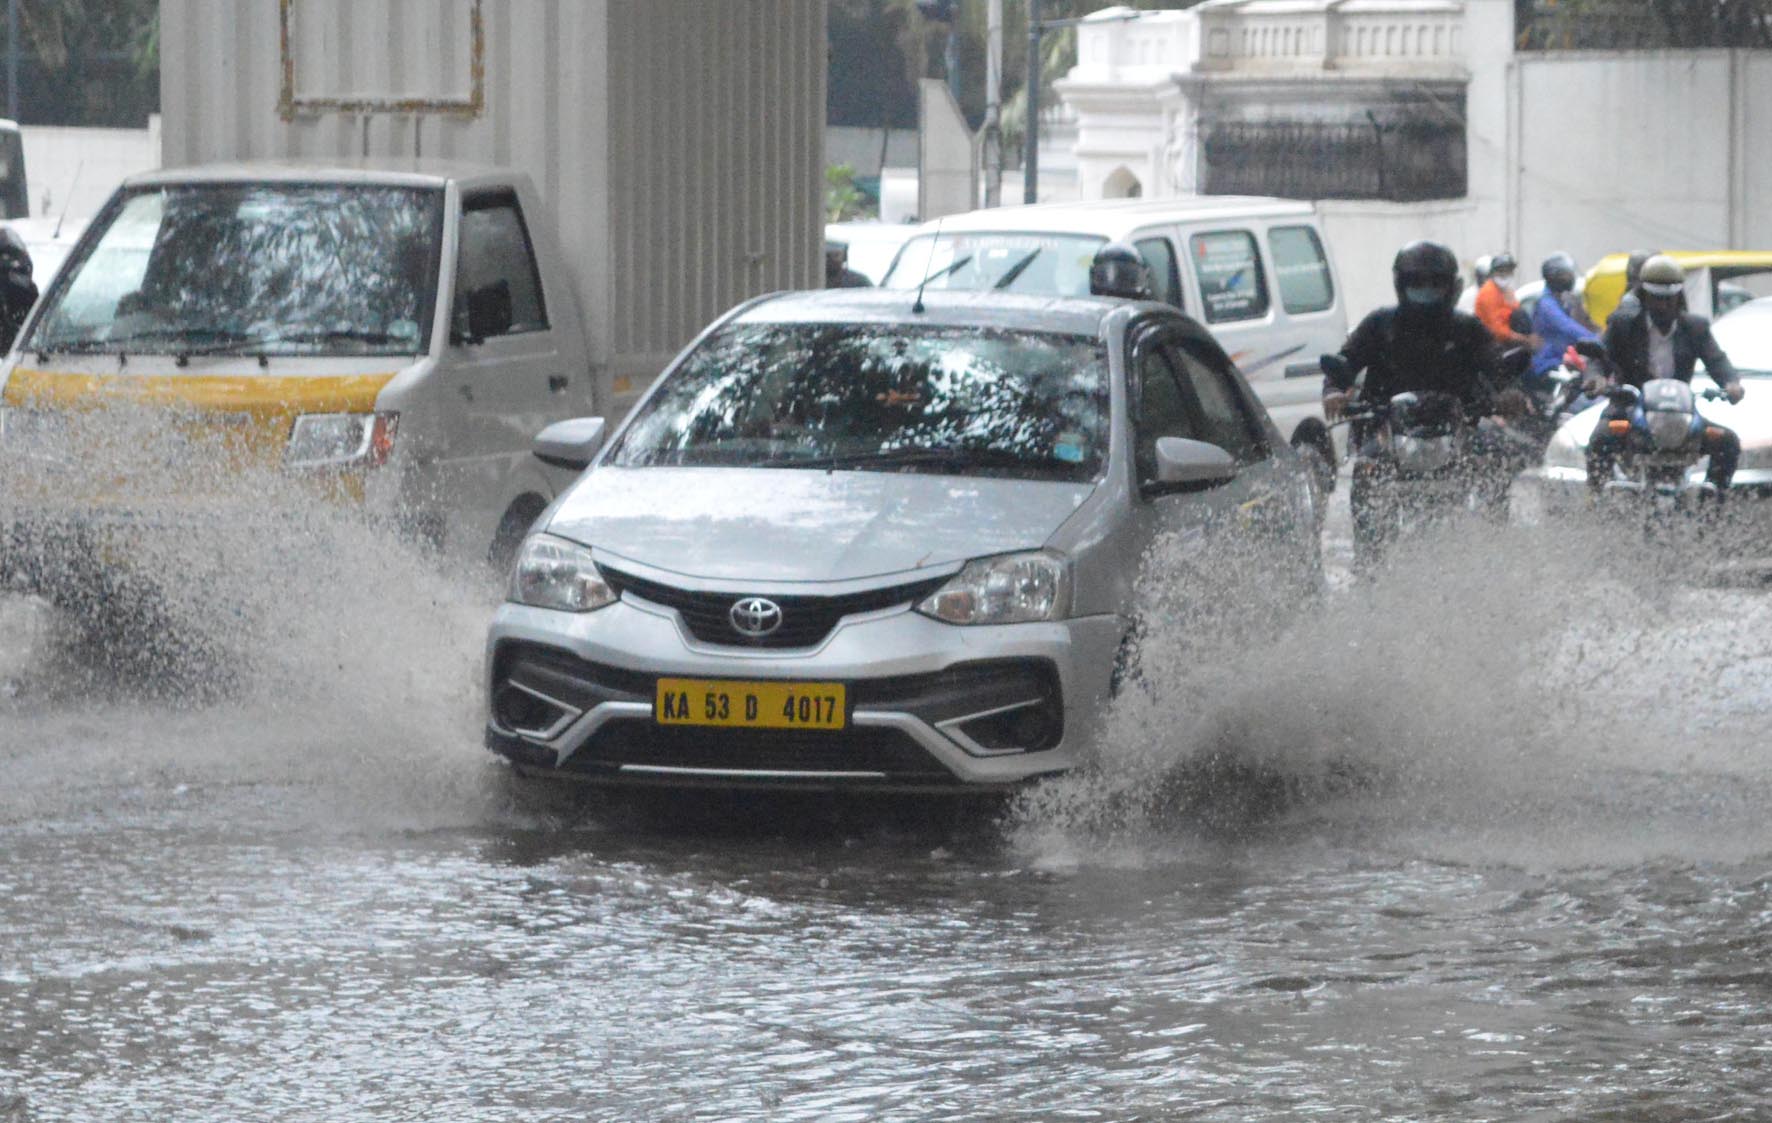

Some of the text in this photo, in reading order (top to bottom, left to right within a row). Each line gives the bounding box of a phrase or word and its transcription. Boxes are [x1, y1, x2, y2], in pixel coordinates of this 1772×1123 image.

[663, 691, 836, 723] KA 53 D 4017
